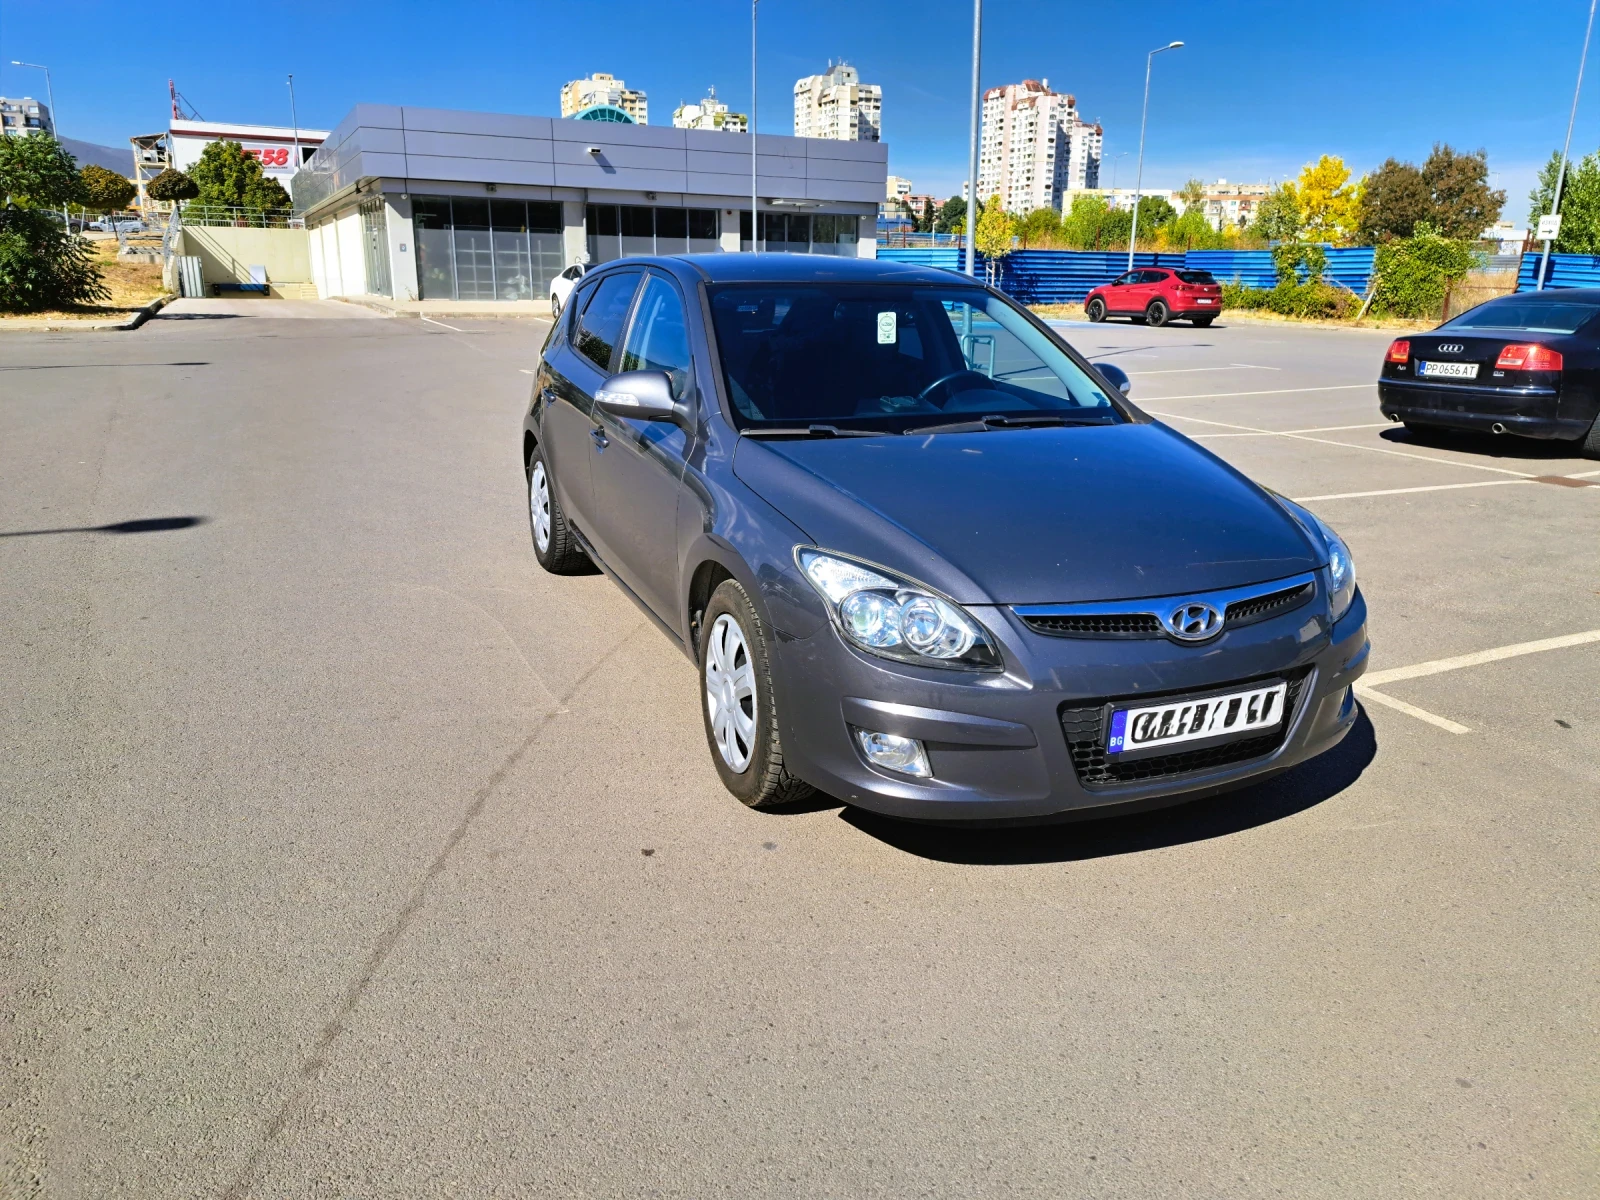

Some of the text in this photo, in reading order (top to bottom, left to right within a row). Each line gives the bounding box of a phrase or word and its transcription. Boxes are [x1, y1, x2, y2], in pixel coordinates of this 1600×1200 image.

[1438, 363, 1461, 375] 0656
[1462, 365, 1476, 376] AT
[1110, 736, 1123, 746] BG
